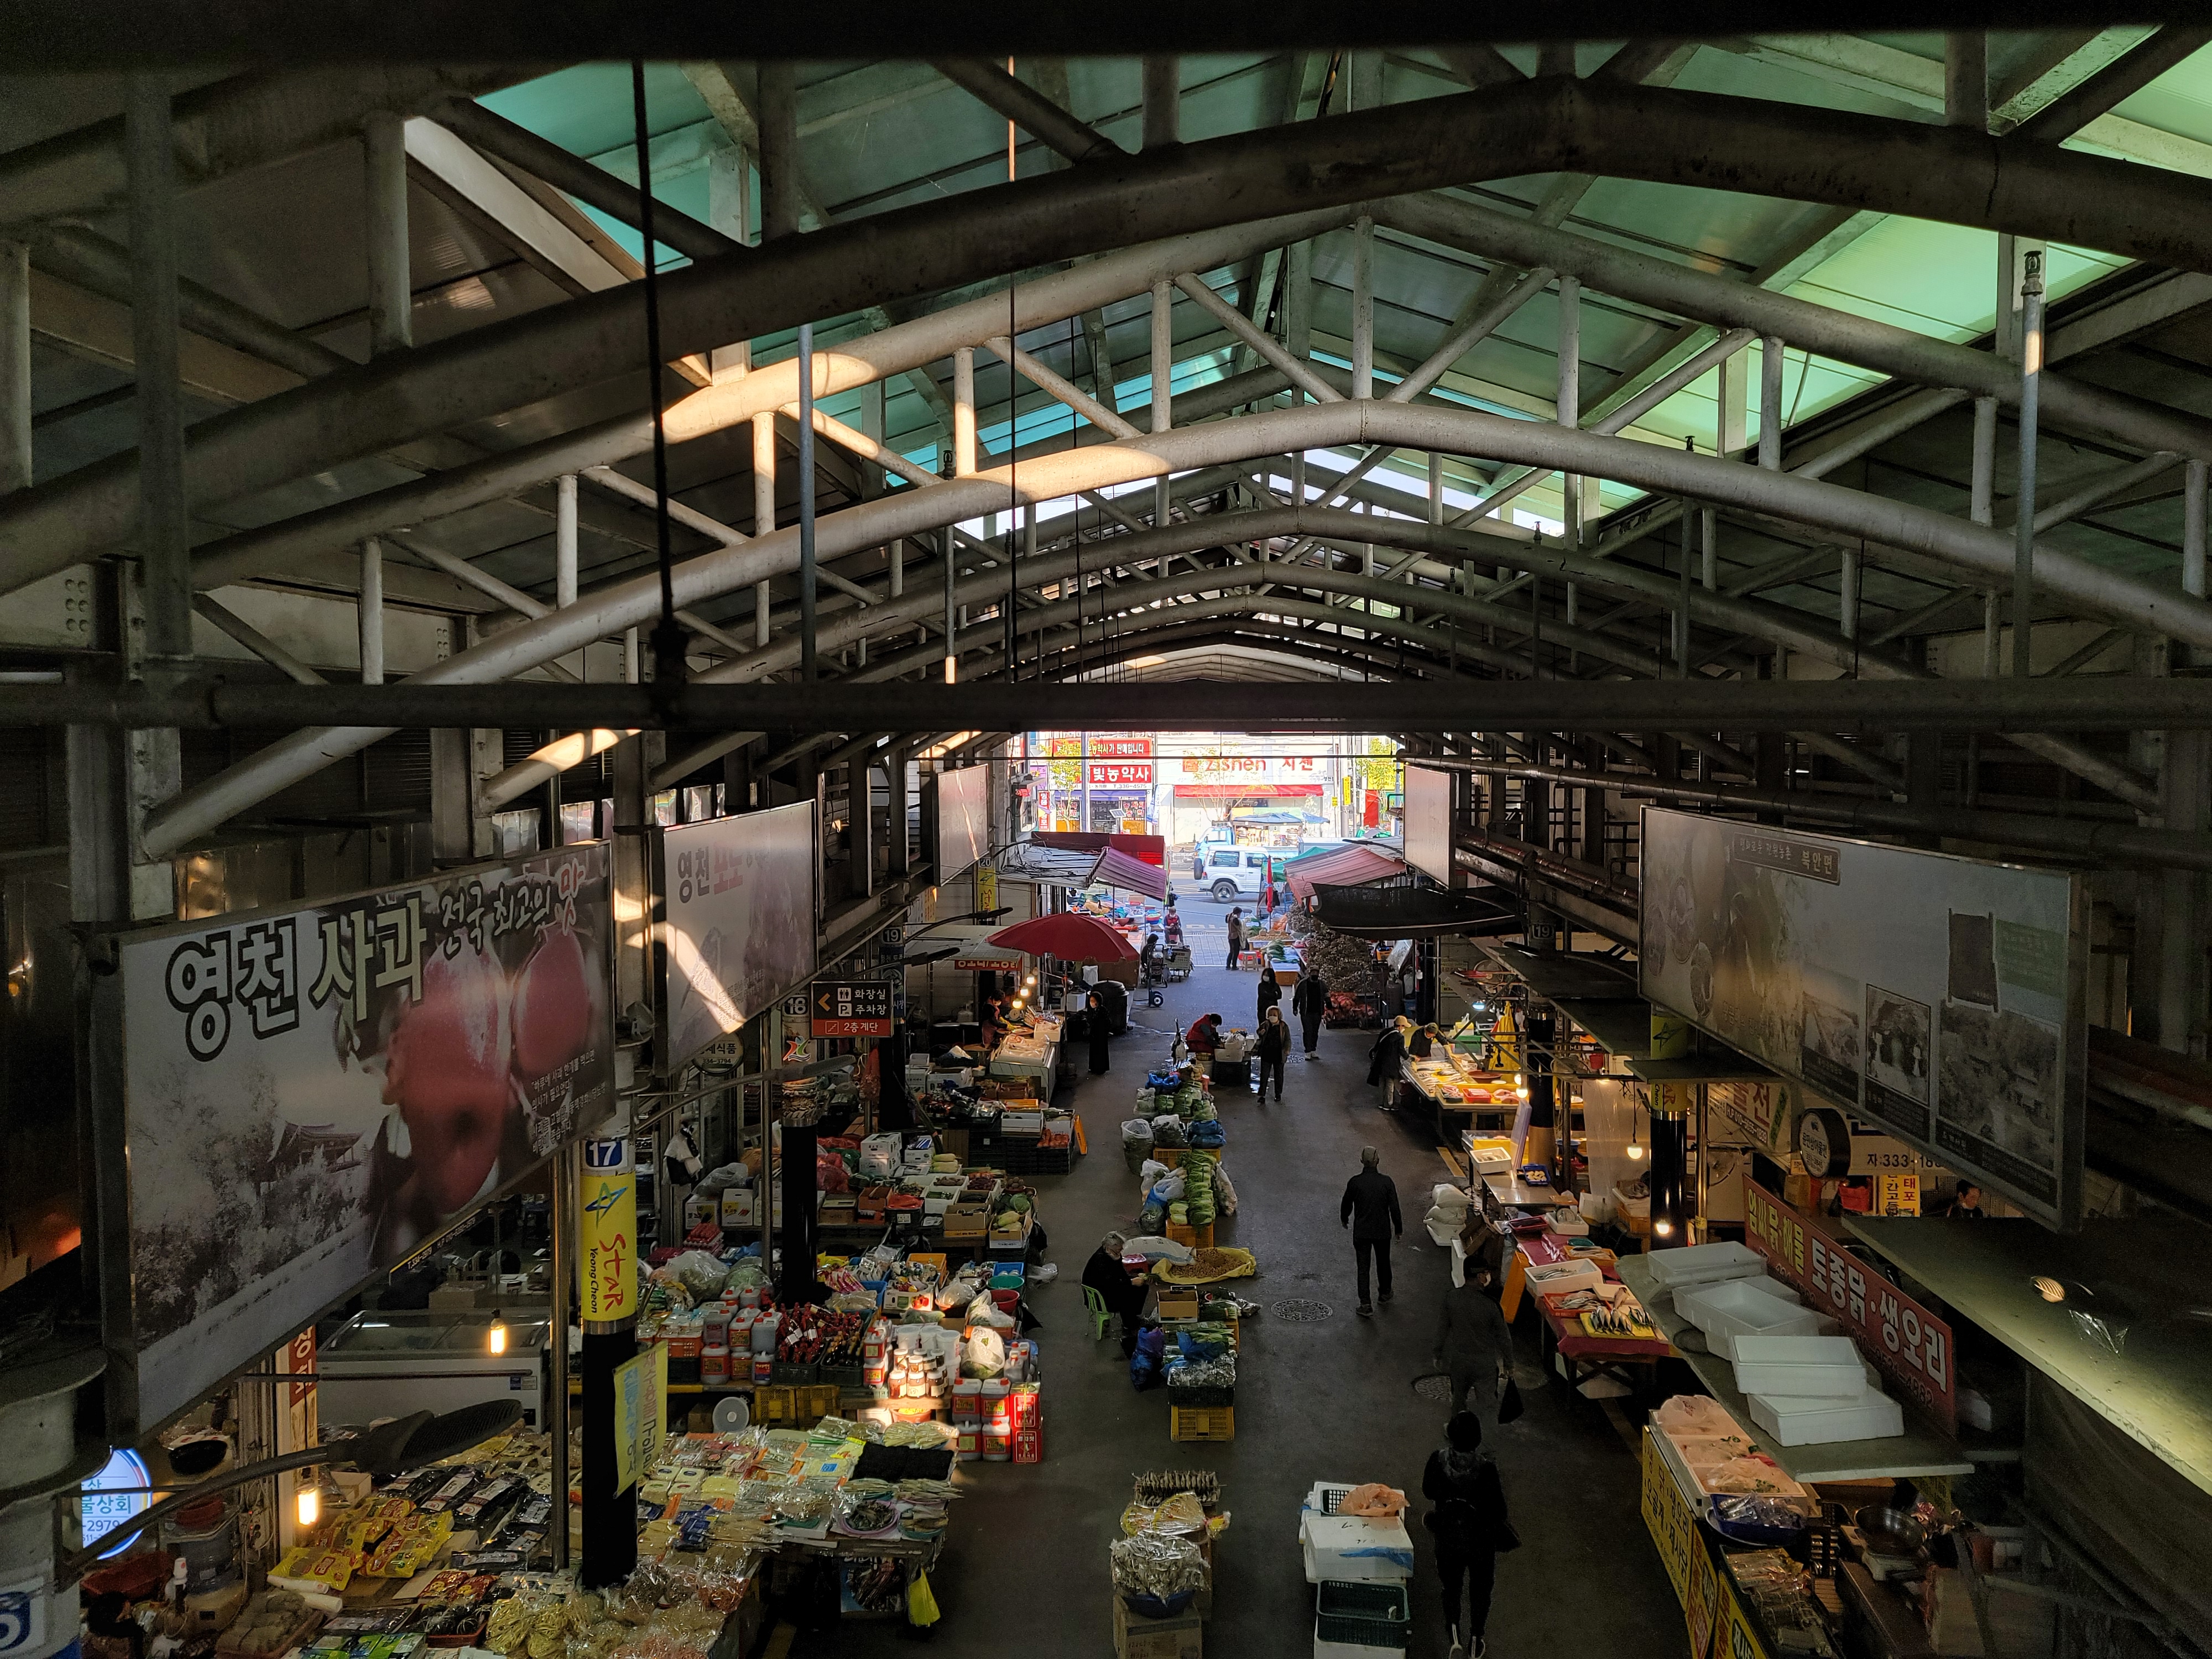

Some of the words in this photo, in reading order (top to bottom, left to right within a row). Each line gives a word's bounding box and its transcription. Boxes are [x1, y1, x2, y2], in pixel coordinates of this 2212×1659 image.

[980, 859, 991, 867] 20
[1802, 850, 1833, 875] 북안면
[677, 847, 709, 904] 영천
[441, 885, 486, 958] 전국
[494, 885, 552, 936] 최고의
[1535, 926, 1550, 937] 19
[885, 930, 901, 942] 19
[166, 919, 298, 1061] 영천
[310, 893, 427, 1022] 사과
[854, 988, 886, 1000] 화장실
[787, 997, 806, 1014] 18
[855, 1004, 887, 1016] 주차장
[843, 1022, 878, 1033] 2층계단
[588, 1140, 617, 1166] 17
[589, 1248, 598, 1279] Yeong
[590, 1280, 599, 1313] Cheon
